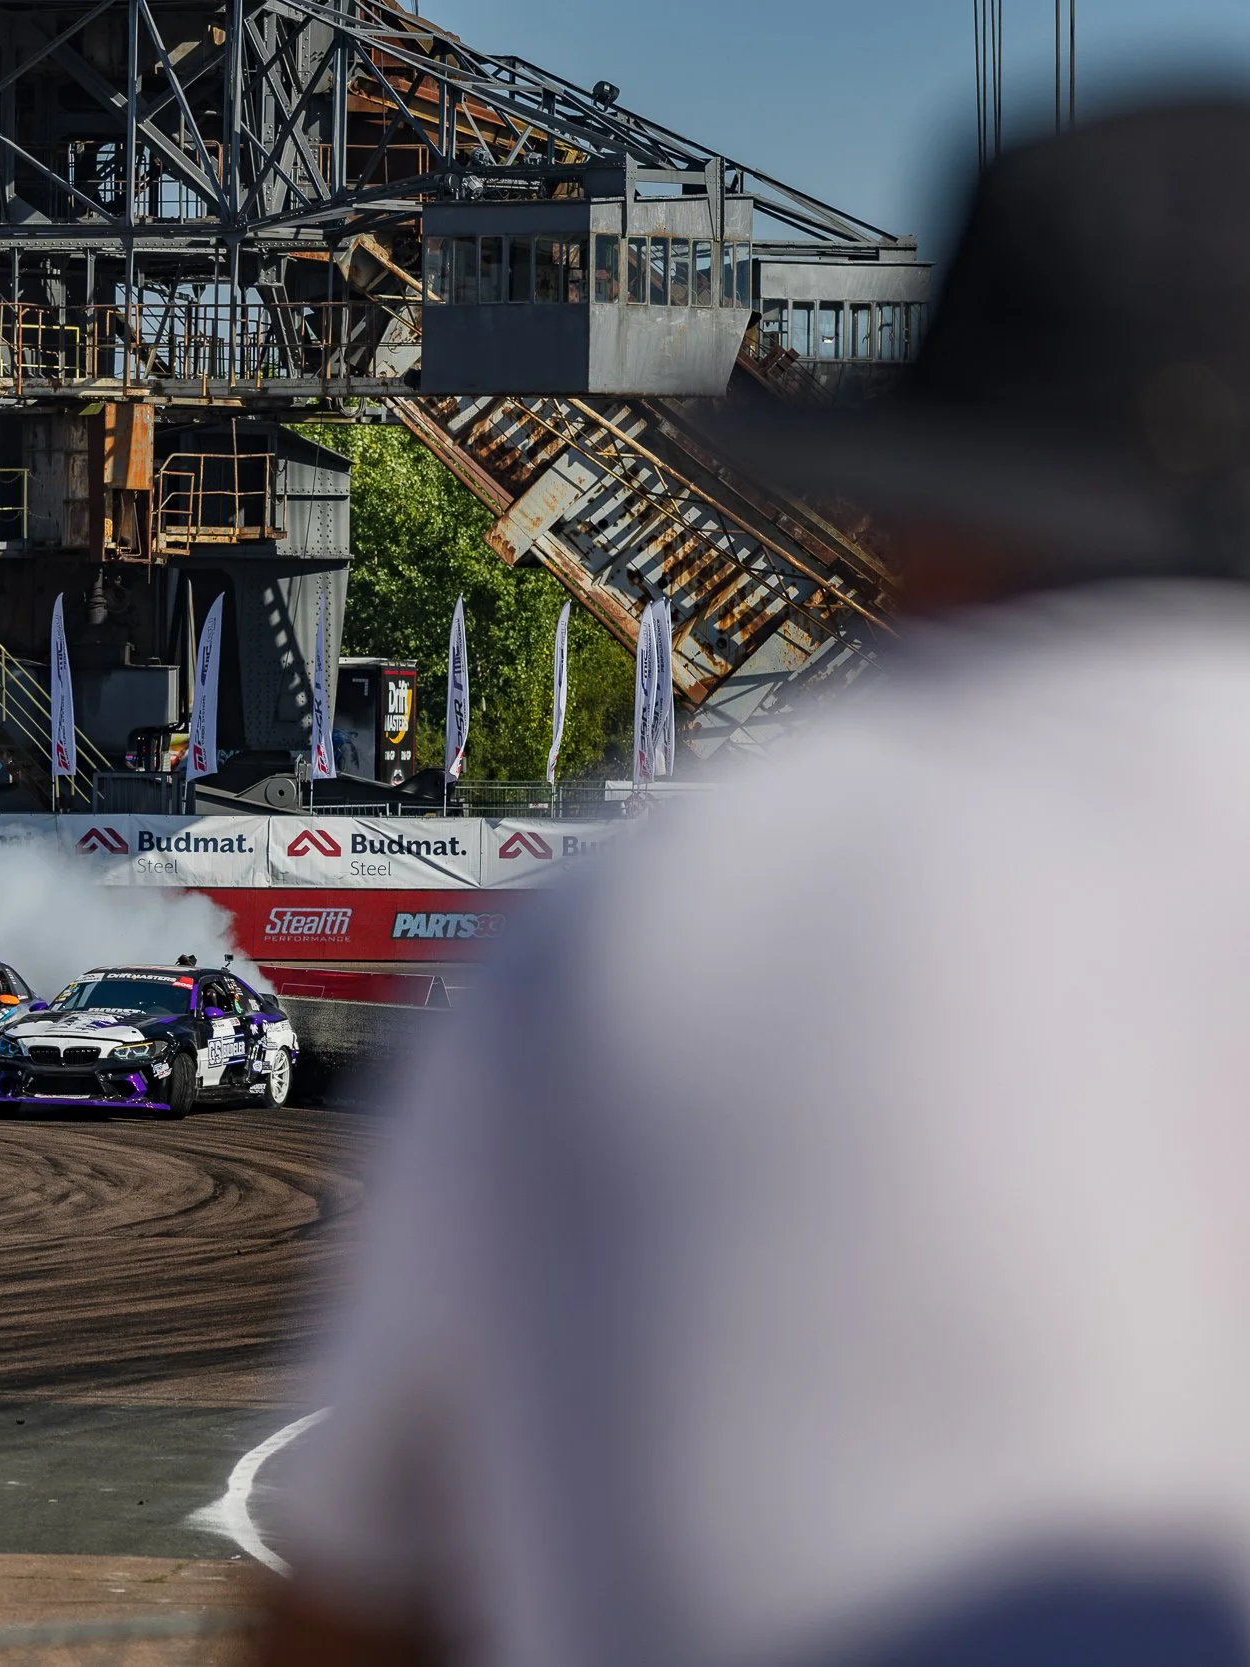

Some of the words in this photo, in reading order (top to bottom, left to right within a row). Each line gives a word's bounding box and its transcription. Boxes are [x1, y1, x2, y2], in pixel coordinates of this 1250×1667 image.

[138, 830, 253, 853] Budmat.
[350, 833, 467, 856] Budmat.
[137, 858, 178, 874] Steel
[350, 860, 391, 876] Steel
[265, 908, 352, 934] Stealth
